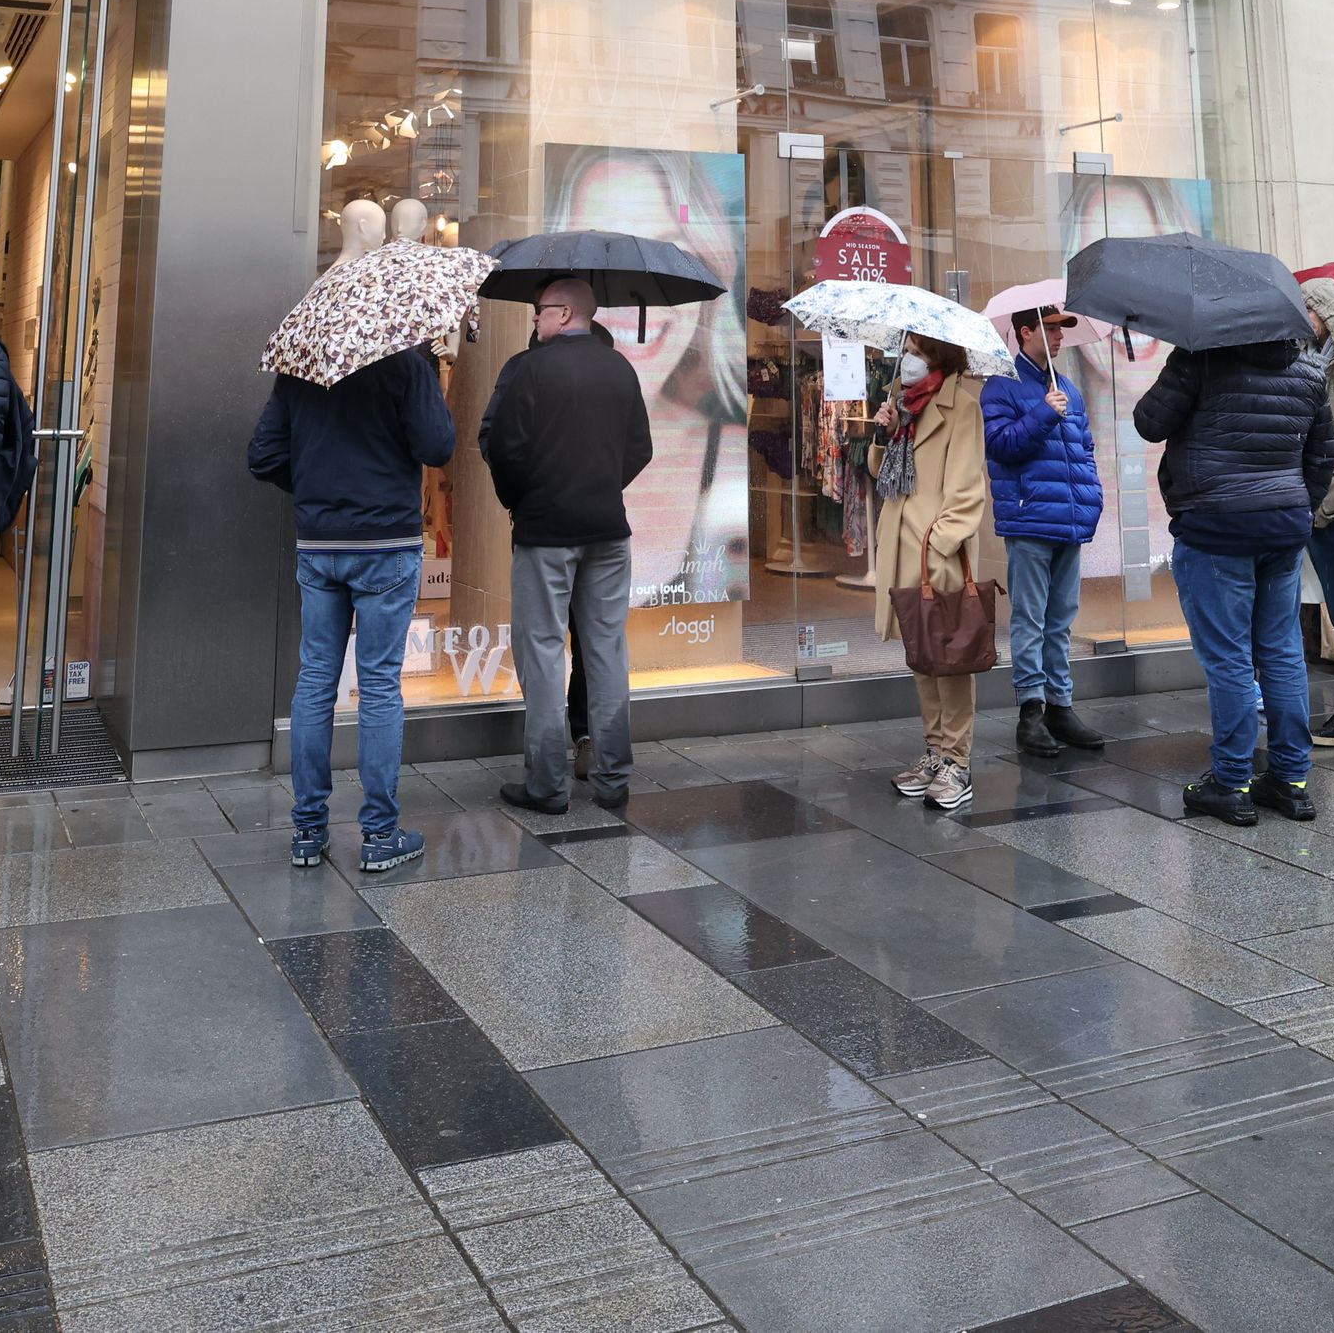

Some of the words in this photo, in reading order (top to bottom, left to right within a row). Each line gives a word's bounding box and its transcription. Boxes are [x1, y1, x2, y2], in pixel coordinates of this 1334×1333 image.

[838, 249, 888, 268] SALE
[636, 586, 657, 596] out
[660, 581, 685, 594] loud
[649, 589, 730, 607] BELDONA
[659, 615, 715, 643] sloggi
[68, 663, 88, 671] SHOP
[68, 670, 83, 678] TAX
[68, 677, 86, 685] FREE
